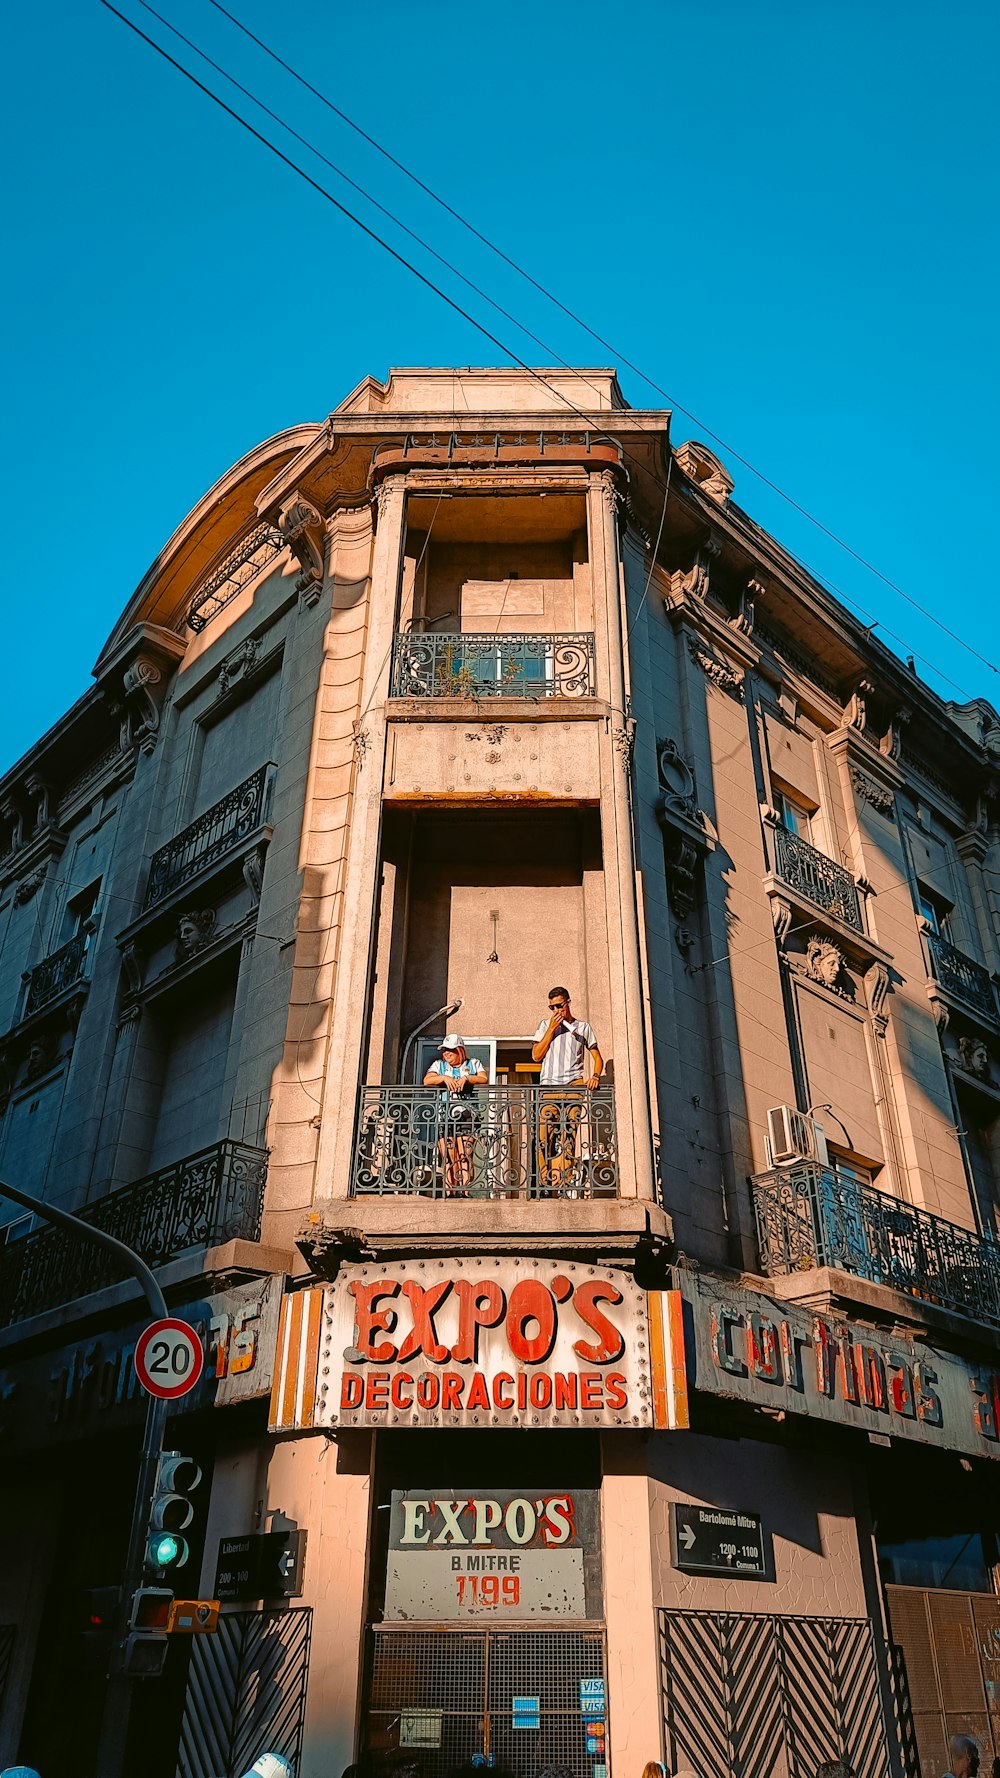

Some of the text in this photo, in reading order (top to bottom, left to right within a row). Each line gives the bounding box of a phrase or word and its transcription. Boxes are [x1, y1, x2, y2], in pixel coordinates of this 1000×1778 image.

[343, 1275, 624, 1365] EXPO'S
[150, 1341, 190, 1375] 20
[340, 1371, 628, 1410] DECORACIONES
[400, 1498, 571, 1545] EXPO'S
[699, 1511, 736, 1526] Bartolomé
[223, 1540, 250, 1554] Libertad
[719, 1543, 736, 1555] 1200
[741, 1545, 758, 1557] 1100
[467, 1555, 521, 1571] MITRE
[218, 1572, 231, 1584] 200
[455, 1575, 520, 1606] 1199
[583, 1681, 604, 1691] VISA
[585, 1702, 605, 1711] VISA
